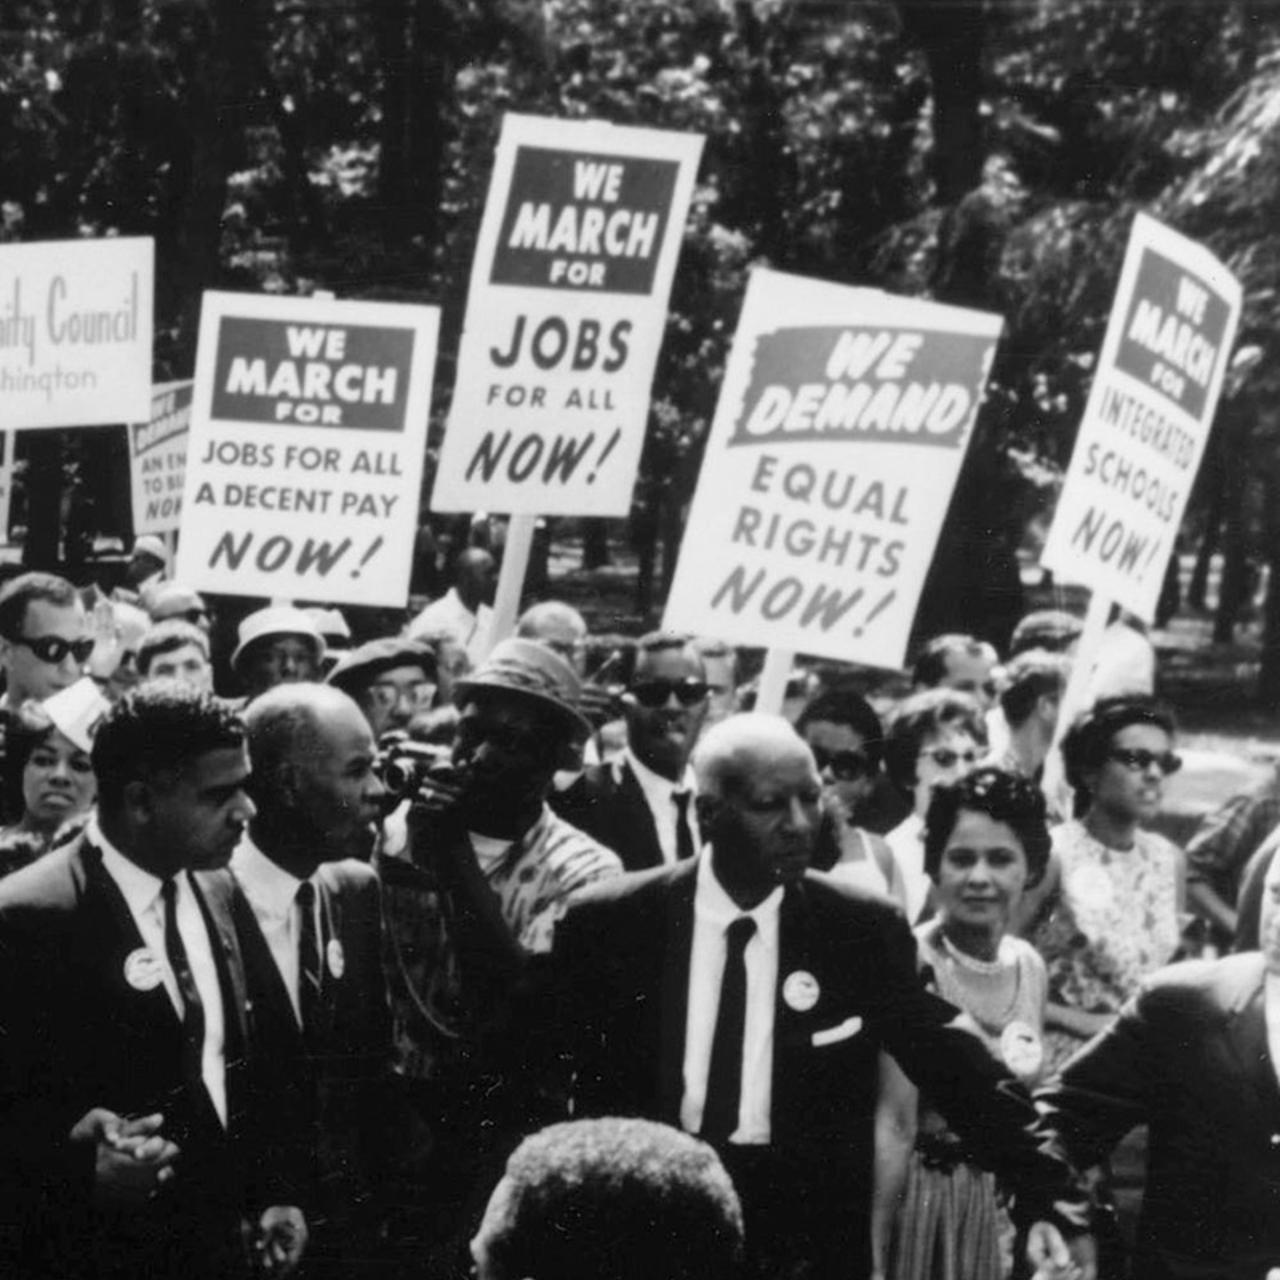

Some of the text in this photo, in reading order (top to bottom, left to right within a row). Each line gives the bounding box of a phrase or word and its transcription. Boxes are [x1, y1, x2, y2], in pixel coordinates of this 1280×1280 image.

[573, 160, 624, 203] WE
[508, 202, 659, 259] MARCH
[548, 259, 607, 286] FOR
[47, 270, 139, 347] Council
[1174, 276, 1211, 326] WE
[285, 327, 348, 358] WE
[488, 314, 634, 373] JOBS
[825, 330, 923, 381] WE
[1127, 300, 1217, 390] MARCH
[225, 358, 398, 405] MARCH
[485, 385, 617, 412] FOR ALL
[1149, 363, 1187, 402] FOR
[273, 403, 343, 426] FOR
[745, 382, 972, 436] DEMAND
[1097, 386, 1196, 471] INTEGRATED
[200, 440, 404, 477] JOBS FOR ALL
[463, 428, 622, 486] NOW!
[1084, 441, 1180, 525] SCHOOLS
[194, 482, 221, 505] A
[223, 484, 333, 517] DECENT
[340, 493, 400, 520] PAY
[750, 455, 911, 526] EQUAL
[207, 530, 385, 580] NOW!
[732, 506, 907, 579] RIGHTS
[1070, 506, 1163, 583] NOW!
[710, 563, 899, 639] NOW!
